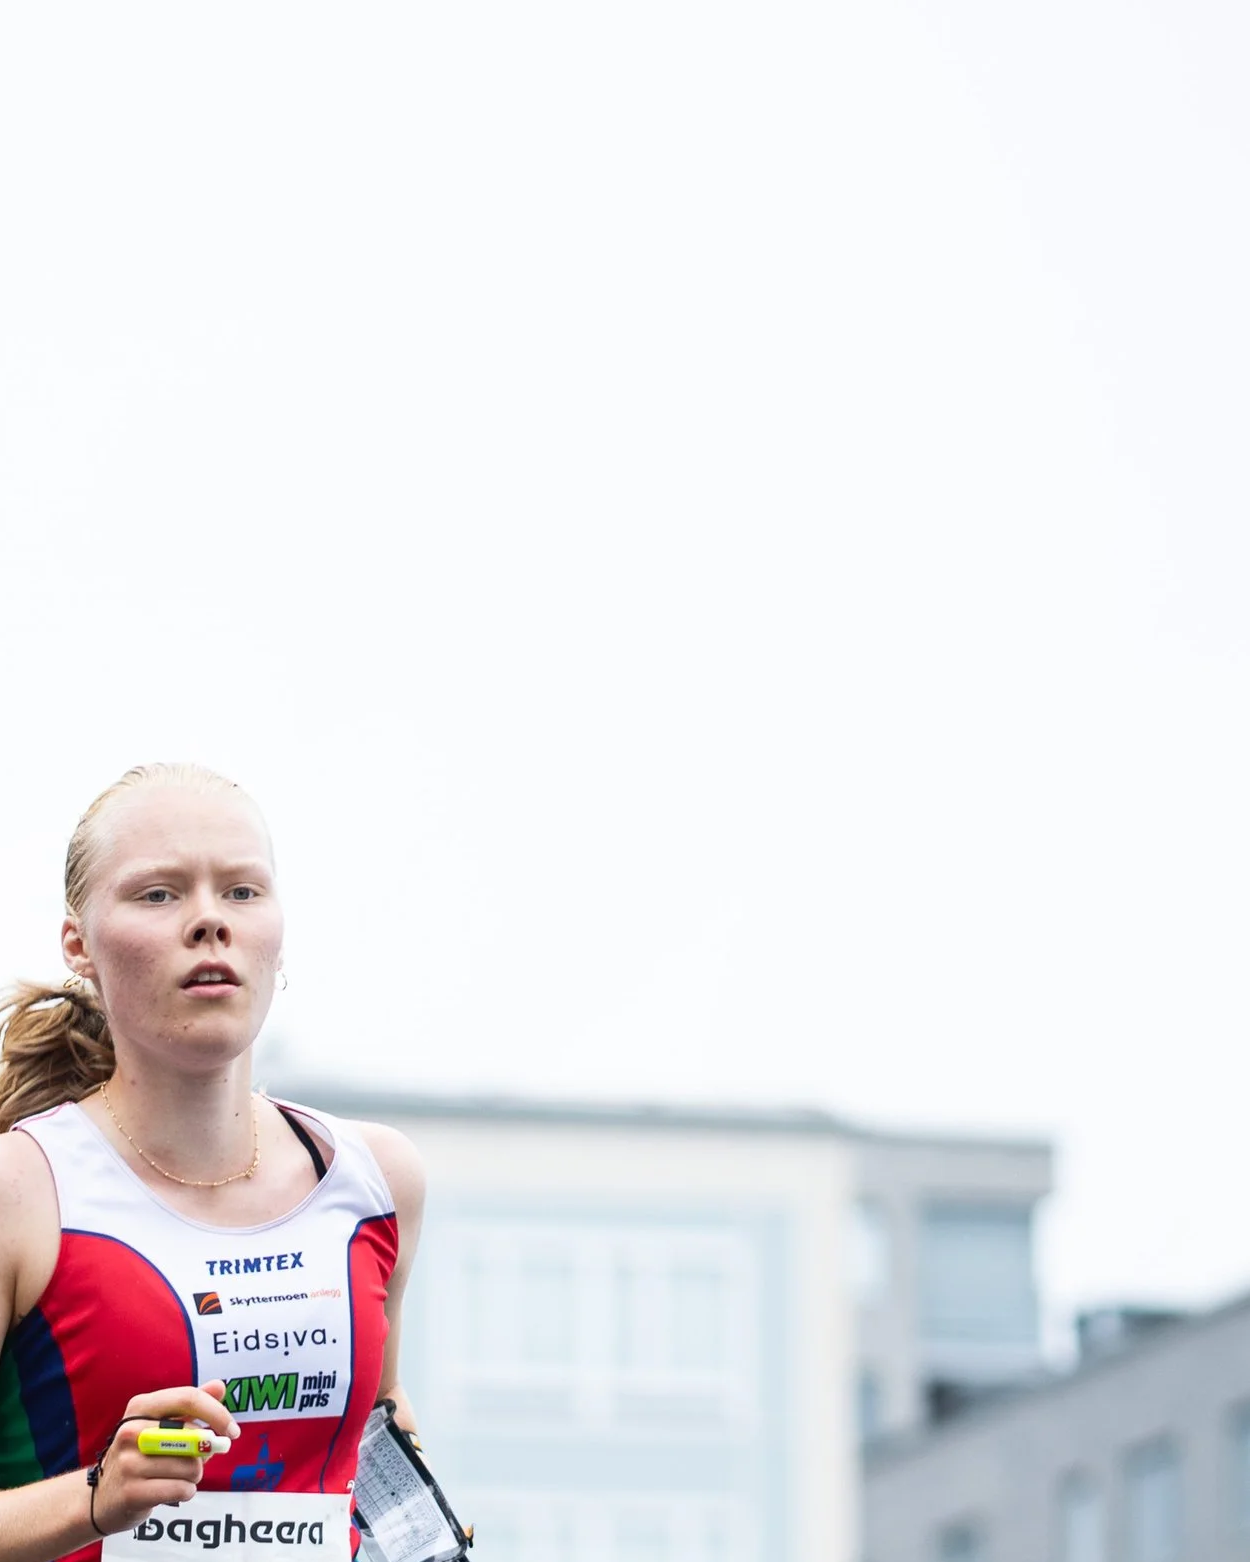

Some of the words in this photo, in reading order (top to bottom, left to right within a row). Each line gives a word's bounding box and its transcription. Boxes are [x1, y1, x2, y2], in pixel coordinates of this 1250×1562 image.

[205, 1251, 304, 1276] TRIMTEX
[229, 1291, 309, 1306] Skyttermoen
[221, 1372, 300, 1413] KIWI
[302, 1370, 337, 1390] mini
[298, 1390, 330, 1412] pris
